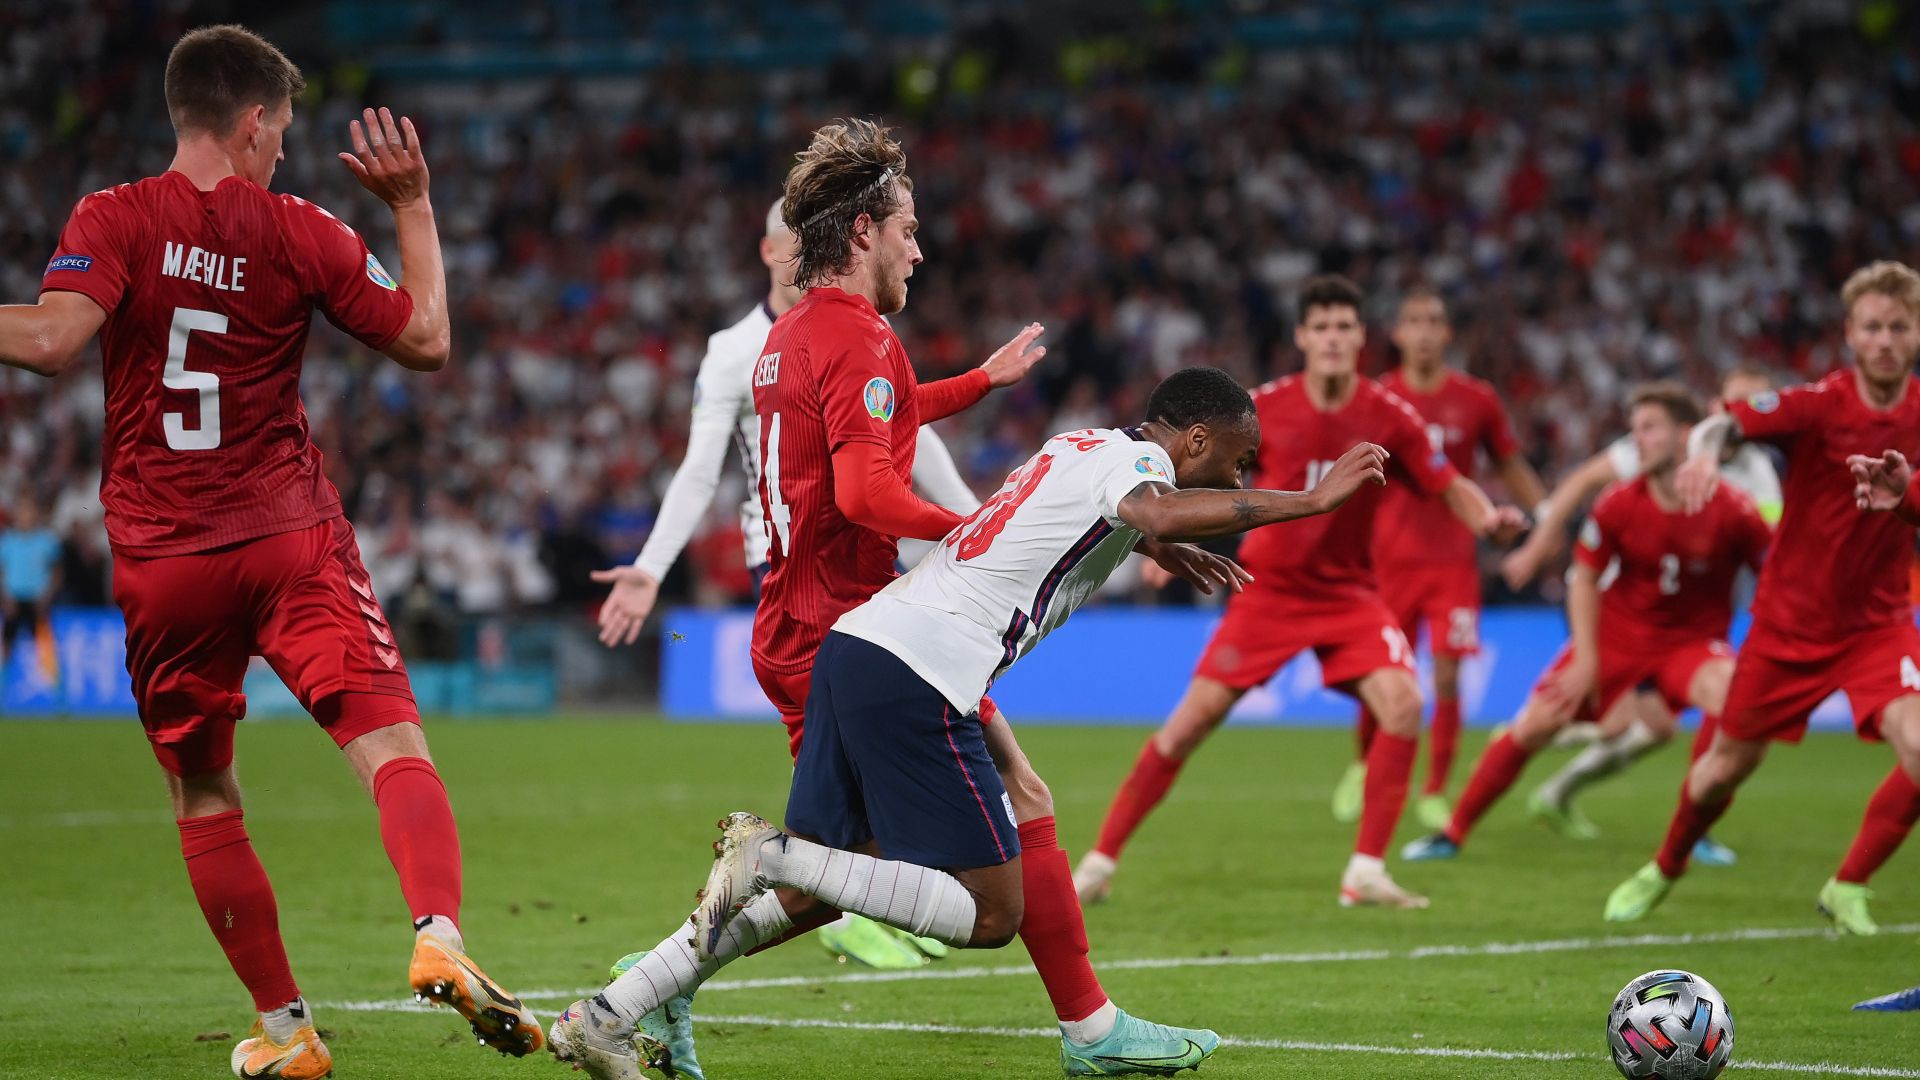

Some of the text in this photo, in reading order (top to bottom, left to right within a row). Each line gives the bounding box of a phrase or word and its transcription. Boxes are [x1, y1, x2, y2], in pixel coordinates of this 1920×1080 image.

[162, 241, 247, 292] MÆHLE
[163, 307, 229, 450] 5
[1659, 553, 1680, 595] 2
